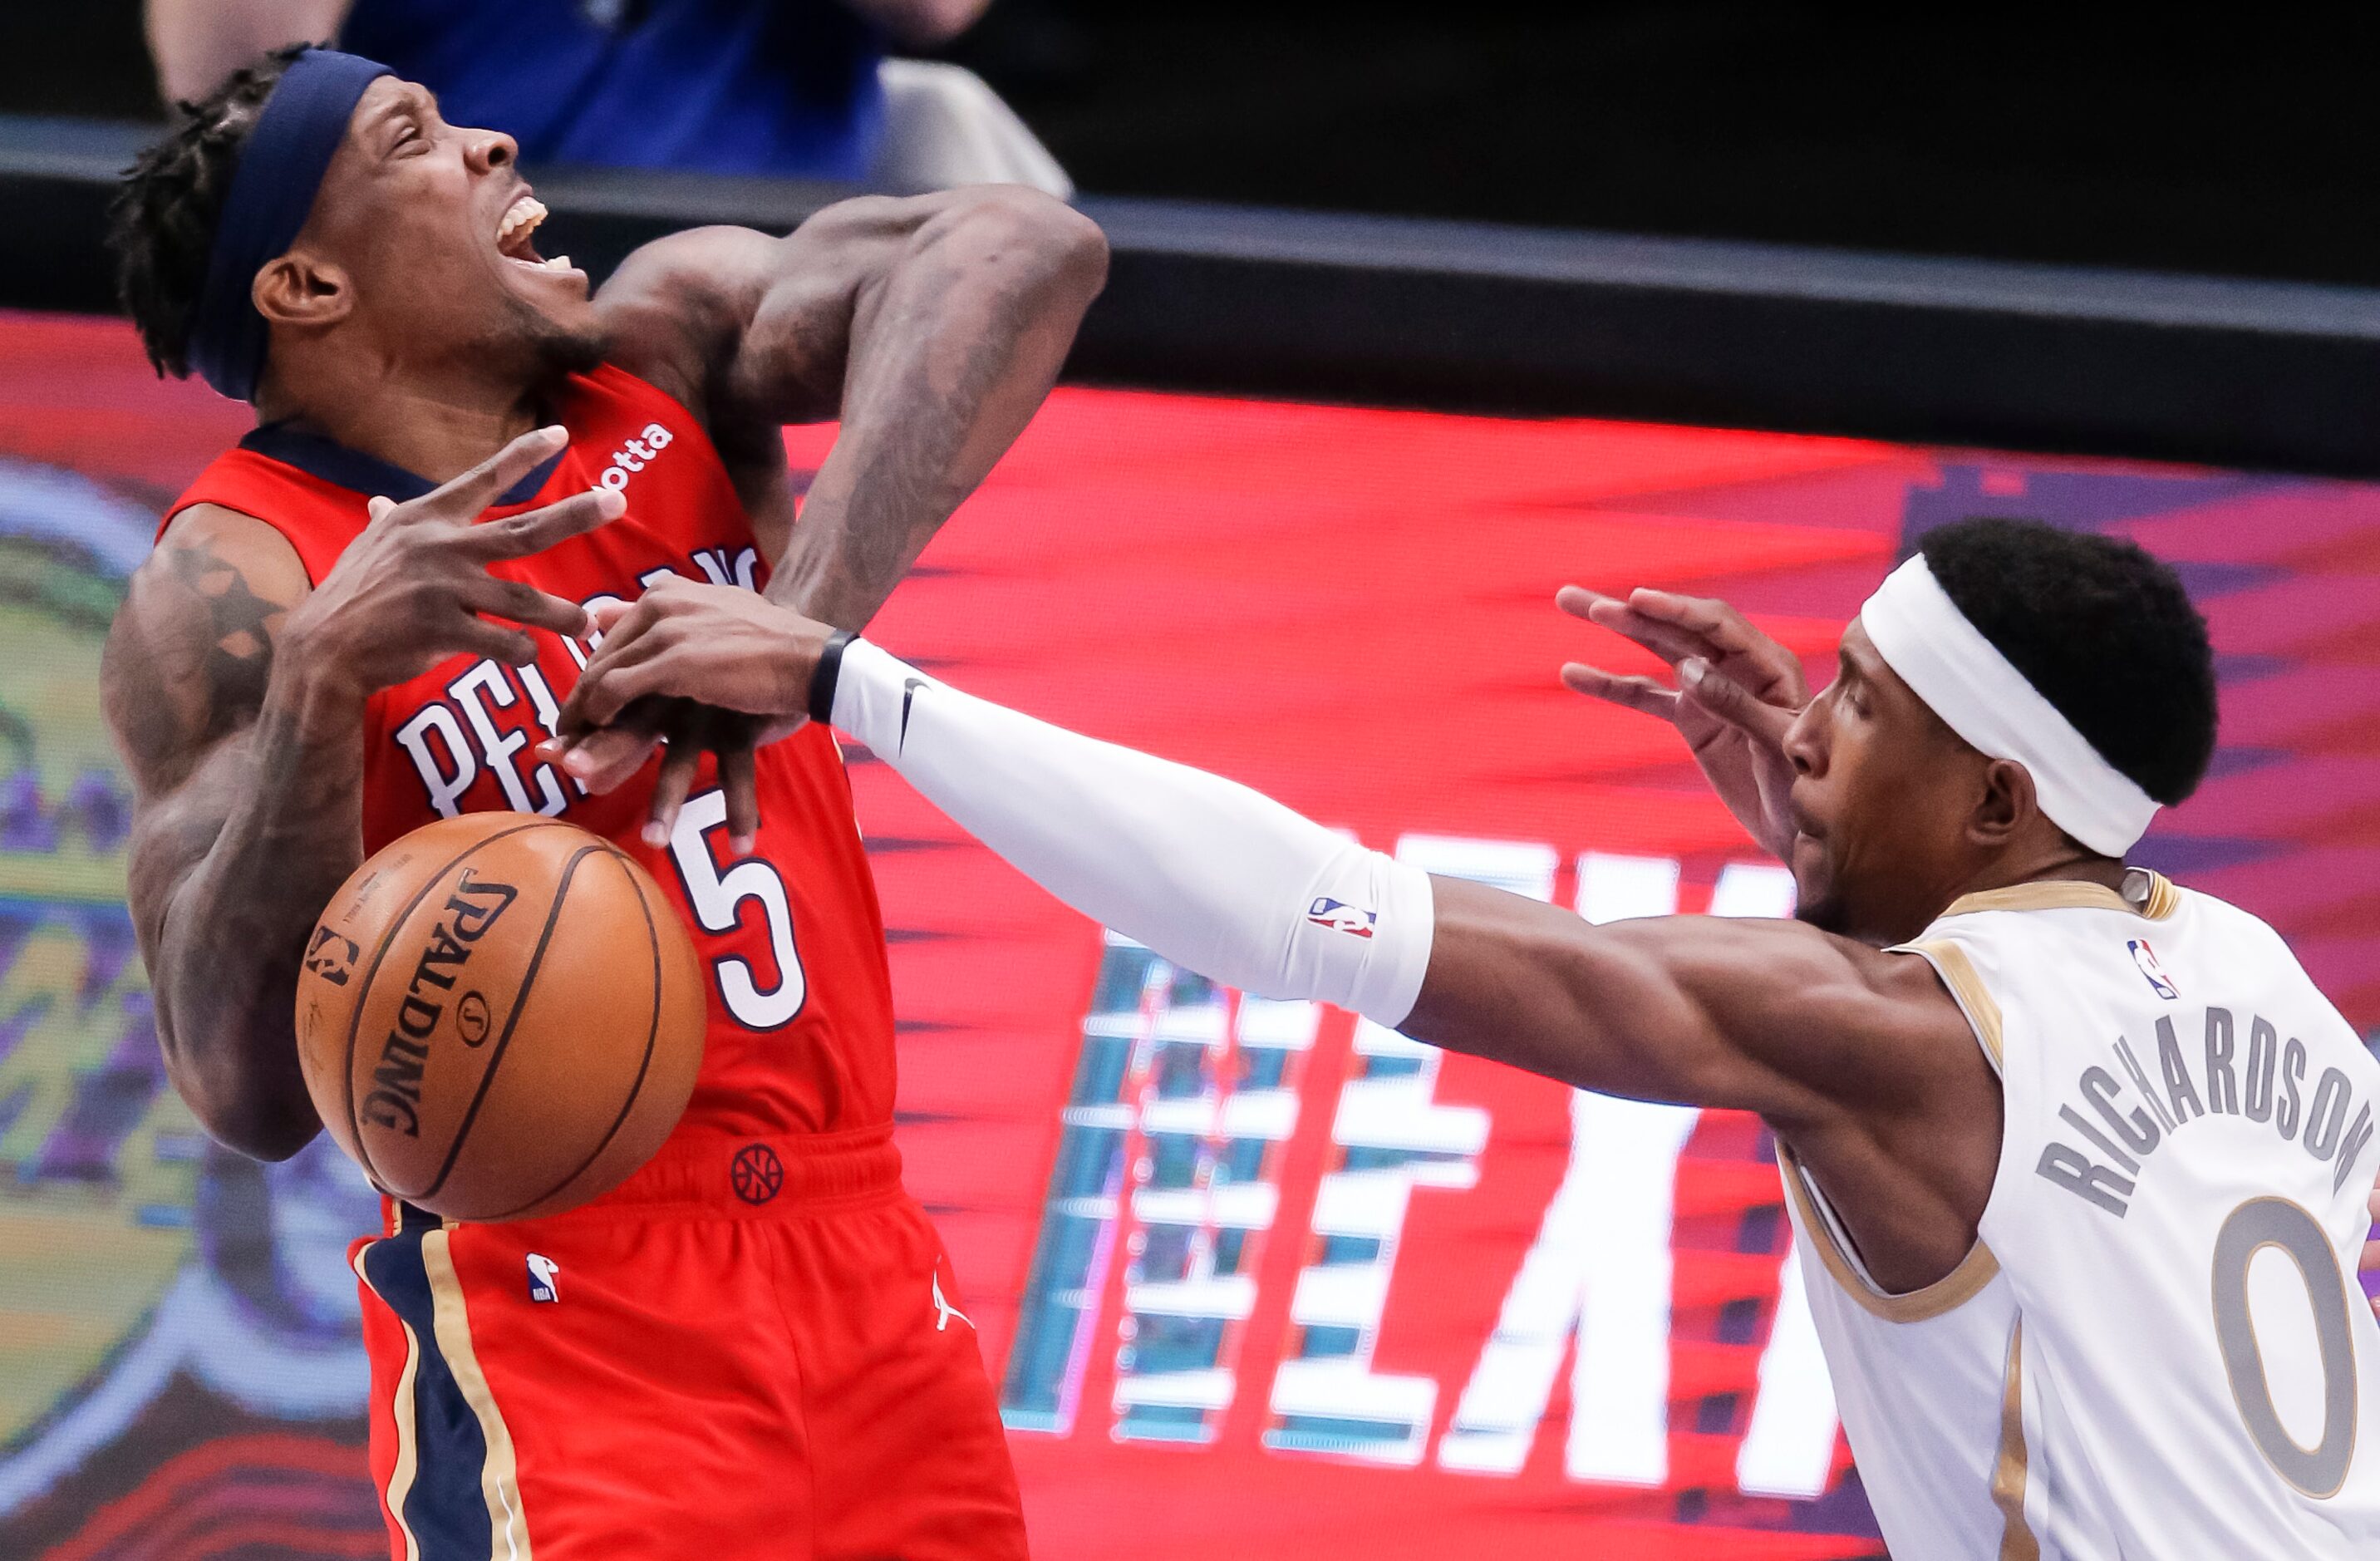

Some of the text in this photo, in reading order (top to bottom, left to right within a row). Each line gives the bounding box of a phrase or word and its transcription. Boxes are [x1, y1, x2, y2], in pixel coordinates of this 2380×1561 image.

[591, 421, 674, 491] otta
[361, 867, 519, 1138] SPALDING
[667, 785, 806, 1032] 5
[2035, 1007, 2373, 1219] RICHARDSON
[533, 1288, 551, 1301] NBA
[2212, 1195, 2358, 1499] 0
